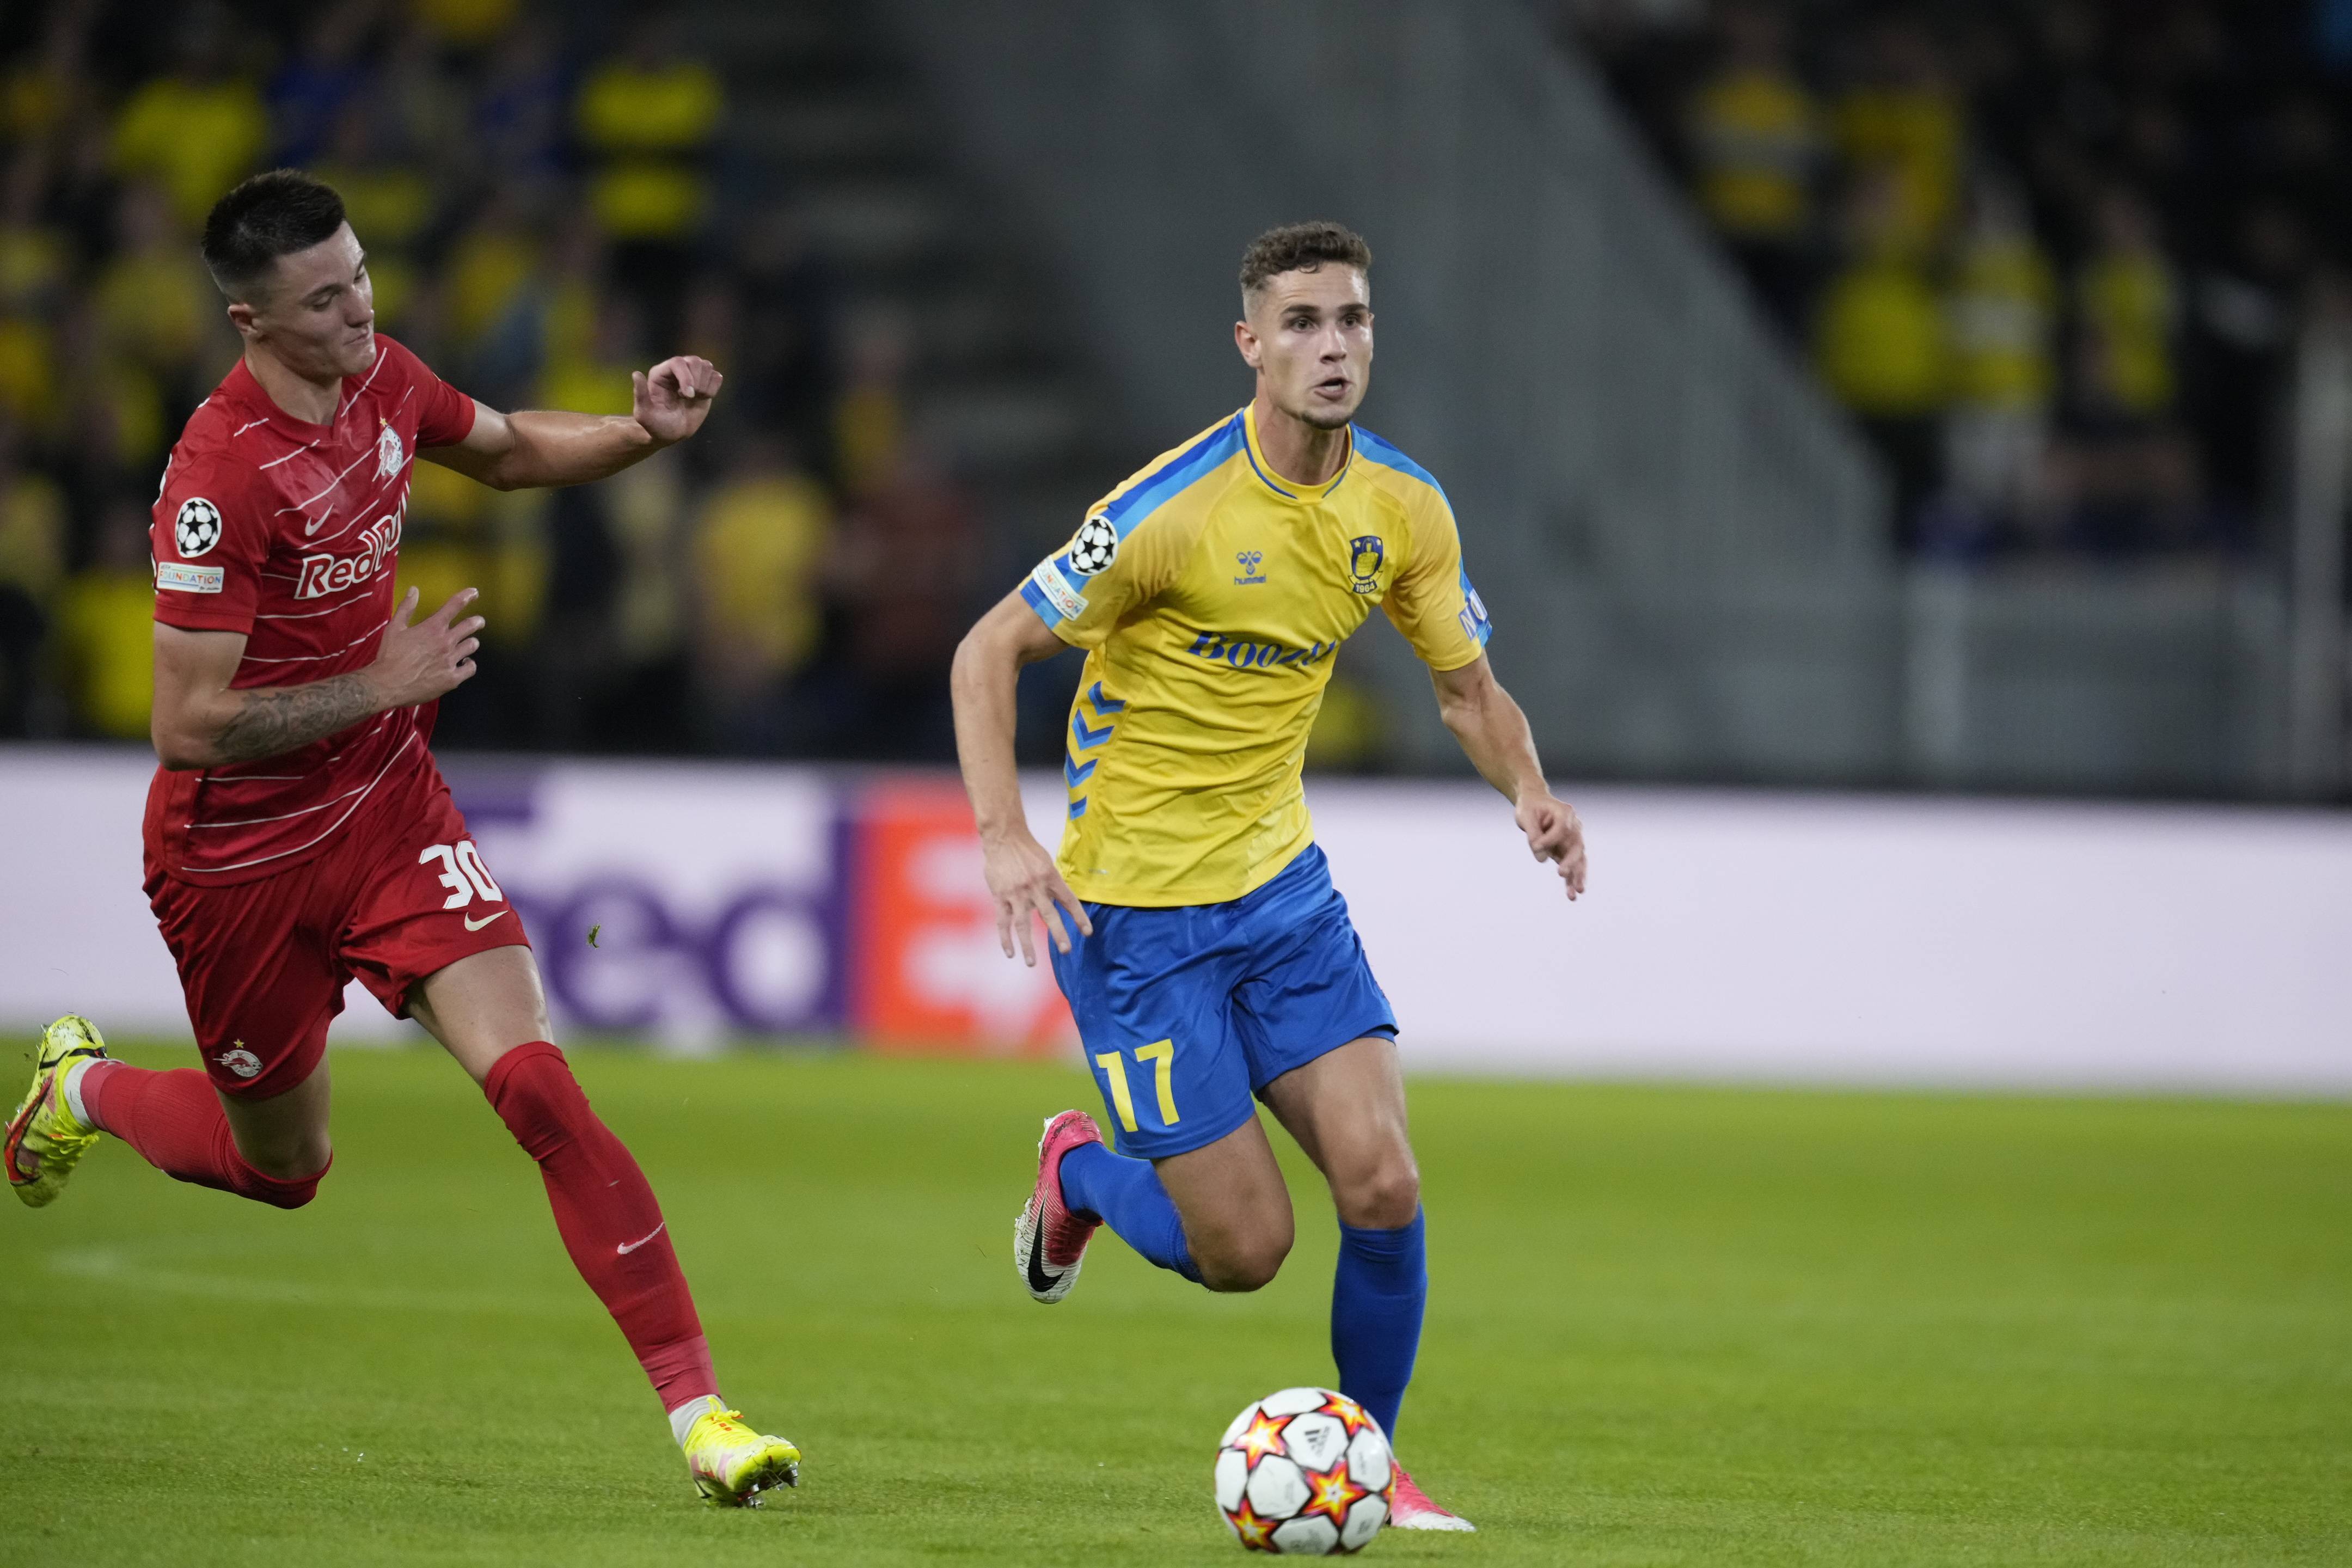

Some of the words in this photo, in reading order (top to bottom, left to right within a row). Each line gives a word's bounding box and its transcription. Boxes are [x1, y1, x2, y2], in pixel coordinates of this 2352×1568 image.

[160, 571, 221, 584] FOUNDATION
[294, 530, 379, 599] Red
[1355, 582, 1375, 593] 1964
[419, 841, 503, 910] 30
[1095, 1038, 1180, 1133] 17
